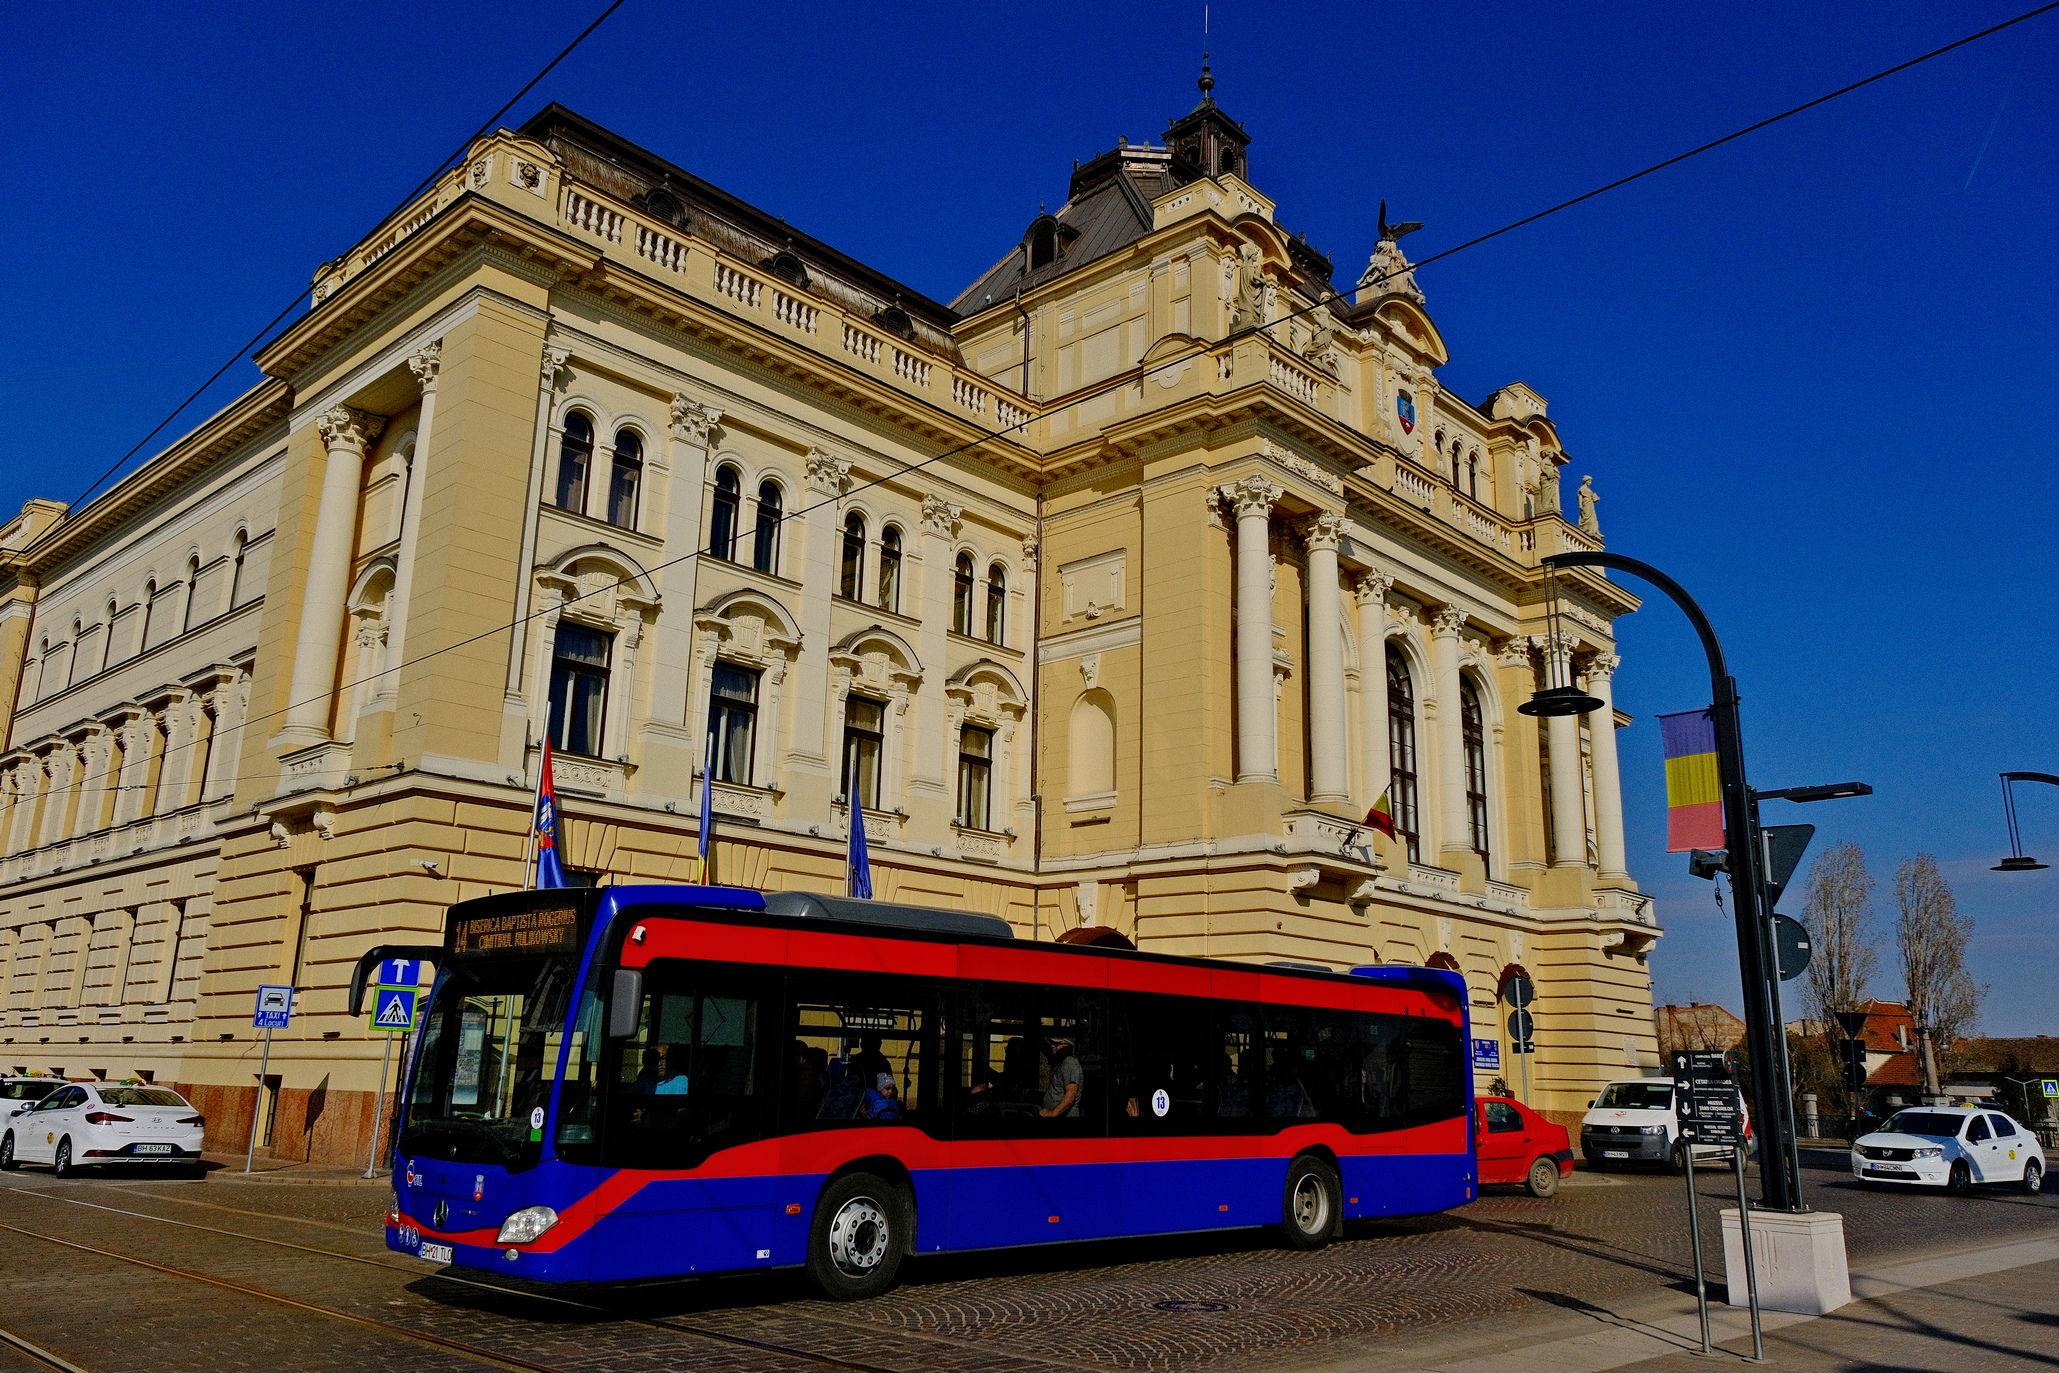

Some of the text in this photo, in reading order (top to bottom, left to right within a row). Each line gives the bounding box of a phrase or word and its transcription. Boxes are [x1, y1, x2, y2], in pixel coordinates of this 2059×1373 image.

[455, 921, 469, 952] 14
[1157, 1096, 1165, 1109] 13
[534, 1112, 541, 1123] 13
[422, 1243, 431, 1258] BH
